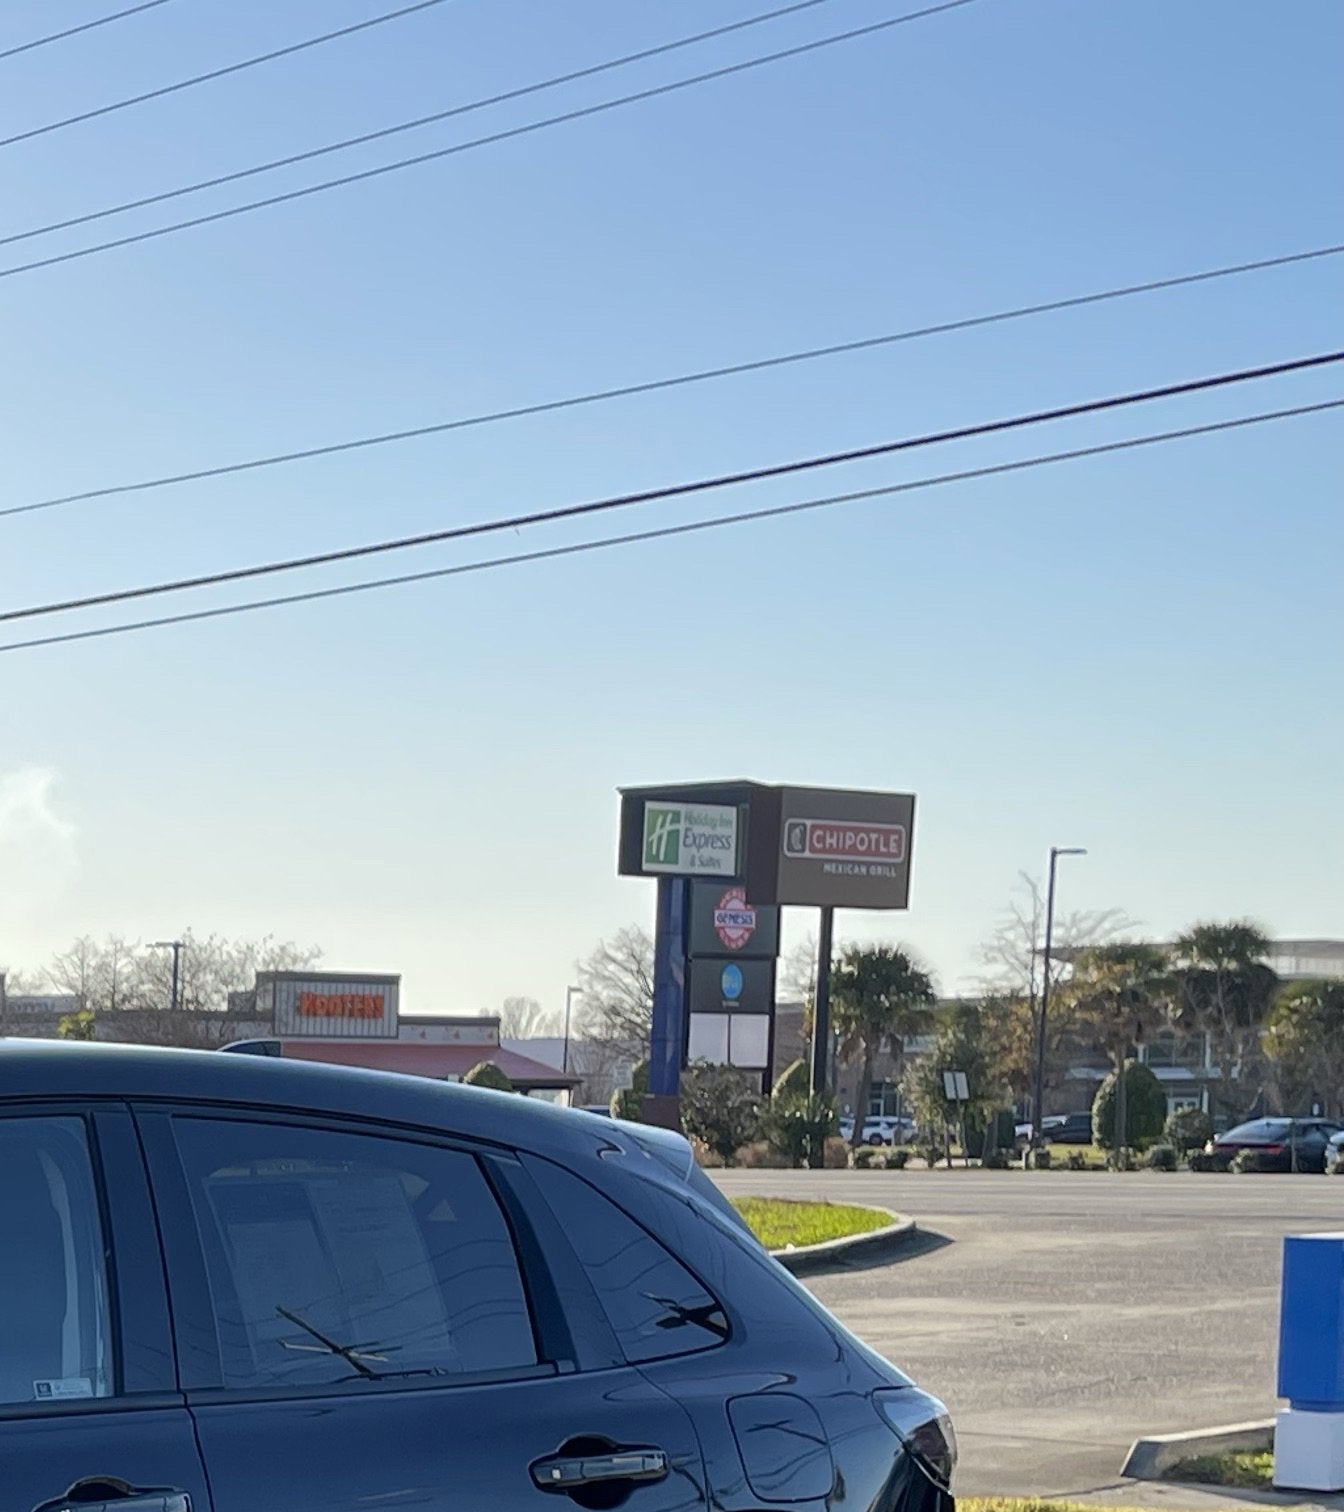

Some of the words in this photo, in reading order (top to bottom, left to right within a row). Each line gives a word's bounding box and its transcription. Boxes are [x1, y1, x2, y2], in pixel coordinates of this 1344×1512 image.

[683, 827, 732, 852] Express
[812, 829, 899, 853] CHIPOTLE
[823, 863, 867, 876] MEXICAN
[869, 865, 896, 877] GRILL
